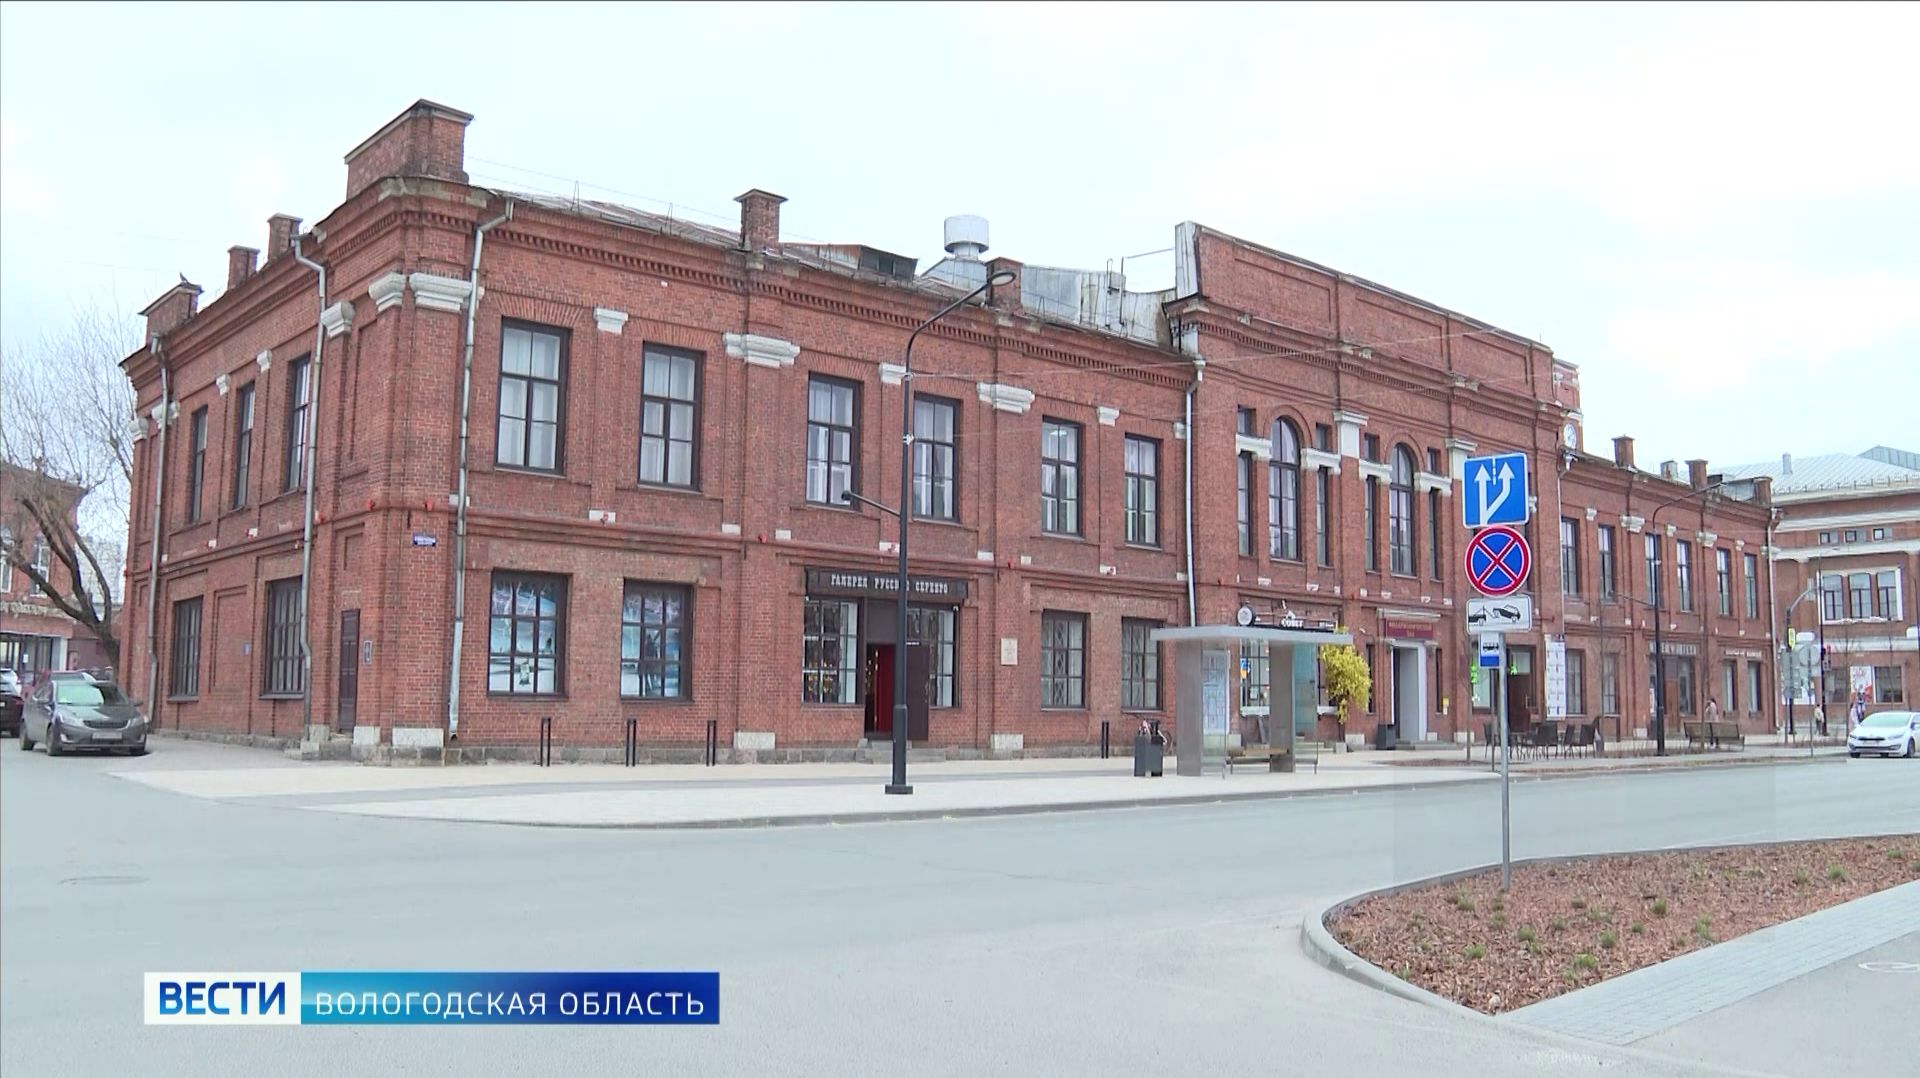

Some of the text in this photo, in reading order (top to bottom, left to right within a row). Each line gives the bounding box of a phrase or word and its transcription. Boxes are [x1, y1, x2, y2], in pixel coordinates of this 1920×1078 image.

[831, 574, 948, 594] ГАЛЕРЕЯ РУССКЕ СЕРЕБРО
